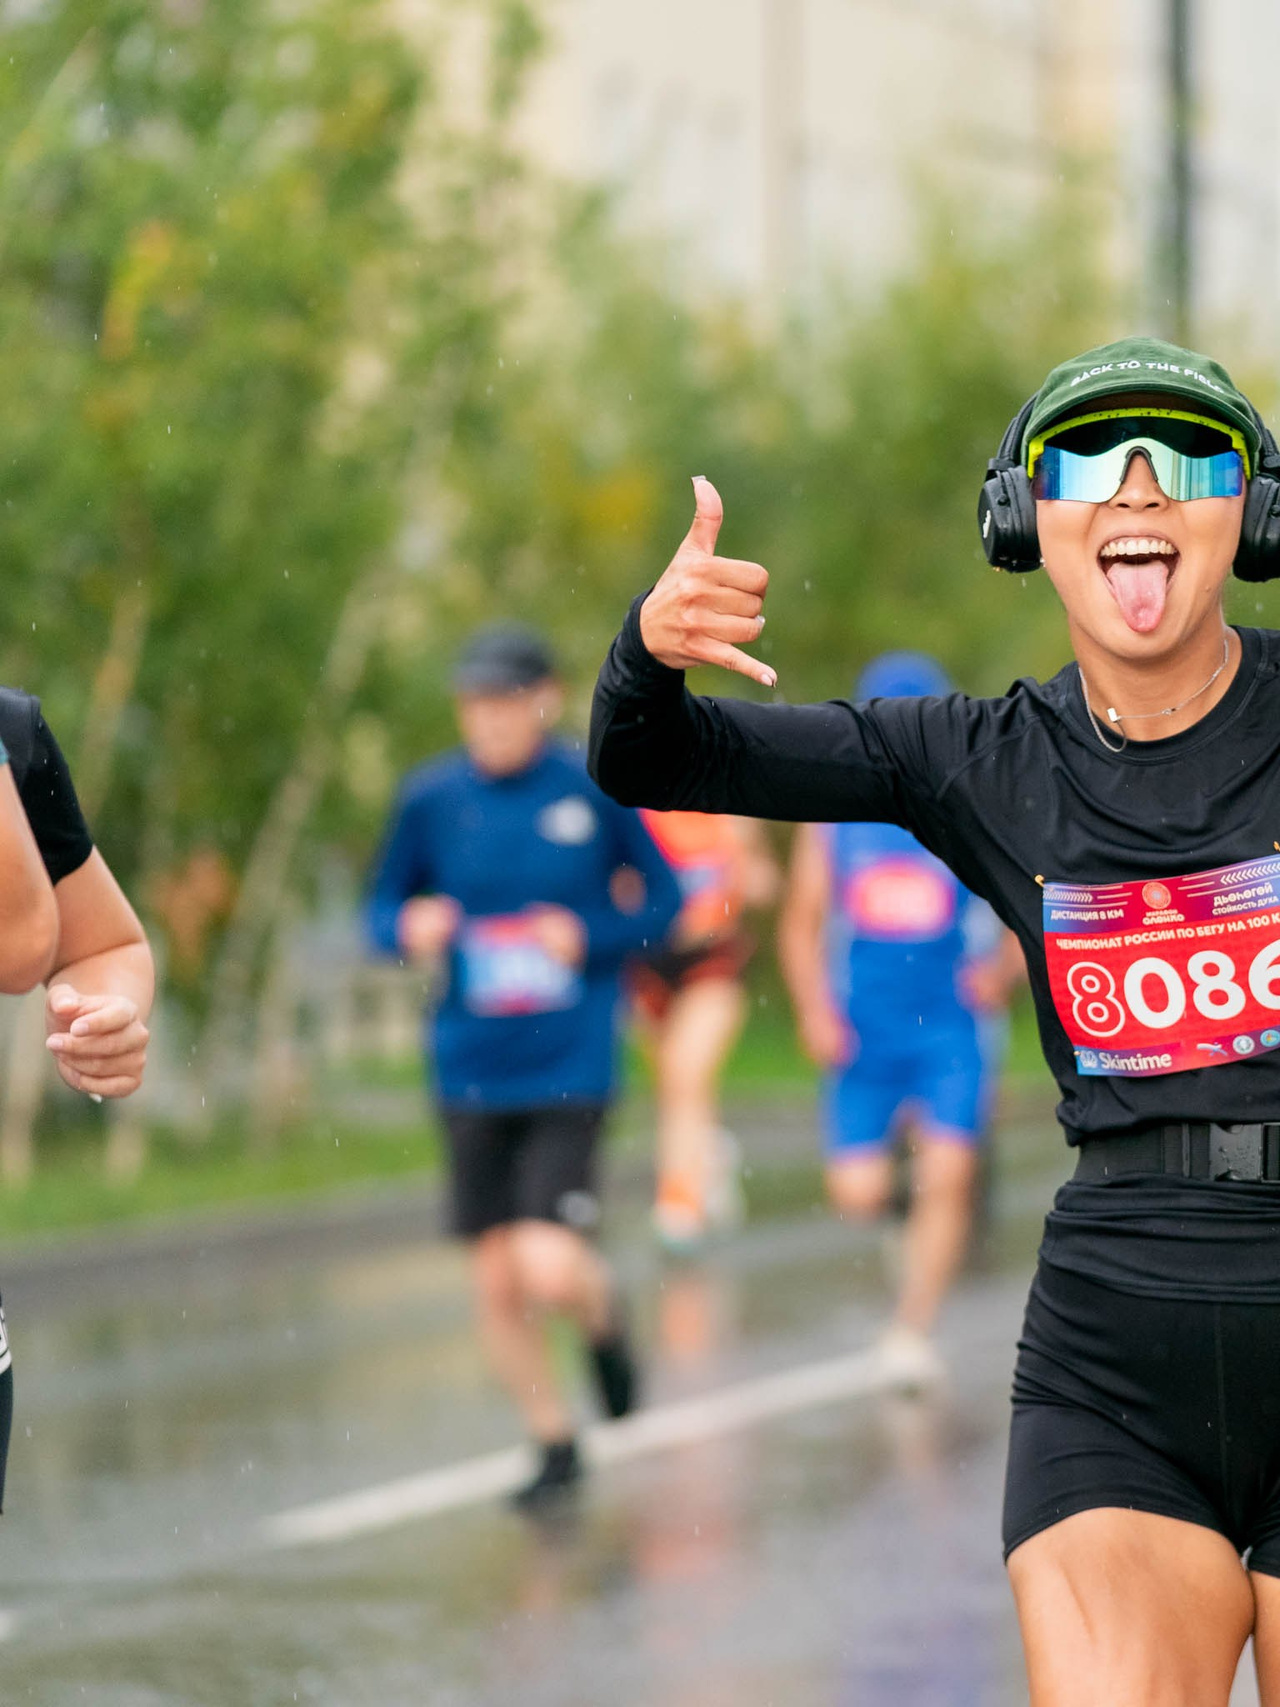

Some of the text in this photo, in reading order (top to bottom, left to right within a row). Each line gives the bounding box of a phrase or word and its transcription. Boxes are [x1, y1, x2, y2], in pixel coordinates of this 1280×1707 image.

[1070, 363, 1113, 387] BACK
[1117, 360, 1141, 371] TO
[1145, 362, 1180, 373] THE
[1050, 909, 1124, 922] ДИСТАНЦИЯ 8 КМ
[1212, 896, 1279, 916] СТОЙКОСТЬ ДУХА
[1056, 937, 1122, 950] ЧЕМПИОНАТ
[1124, 929, 1176, 946] РОССИИ
[1176, 927, 1196, 939] ПО
[1196, 923, 1226, 938] БЕГУ
[1227, 919, 1247, 933] НА
[1247, 915, 1271, 929] 100
[1099, 1052, 1172, 1072] Skintime
